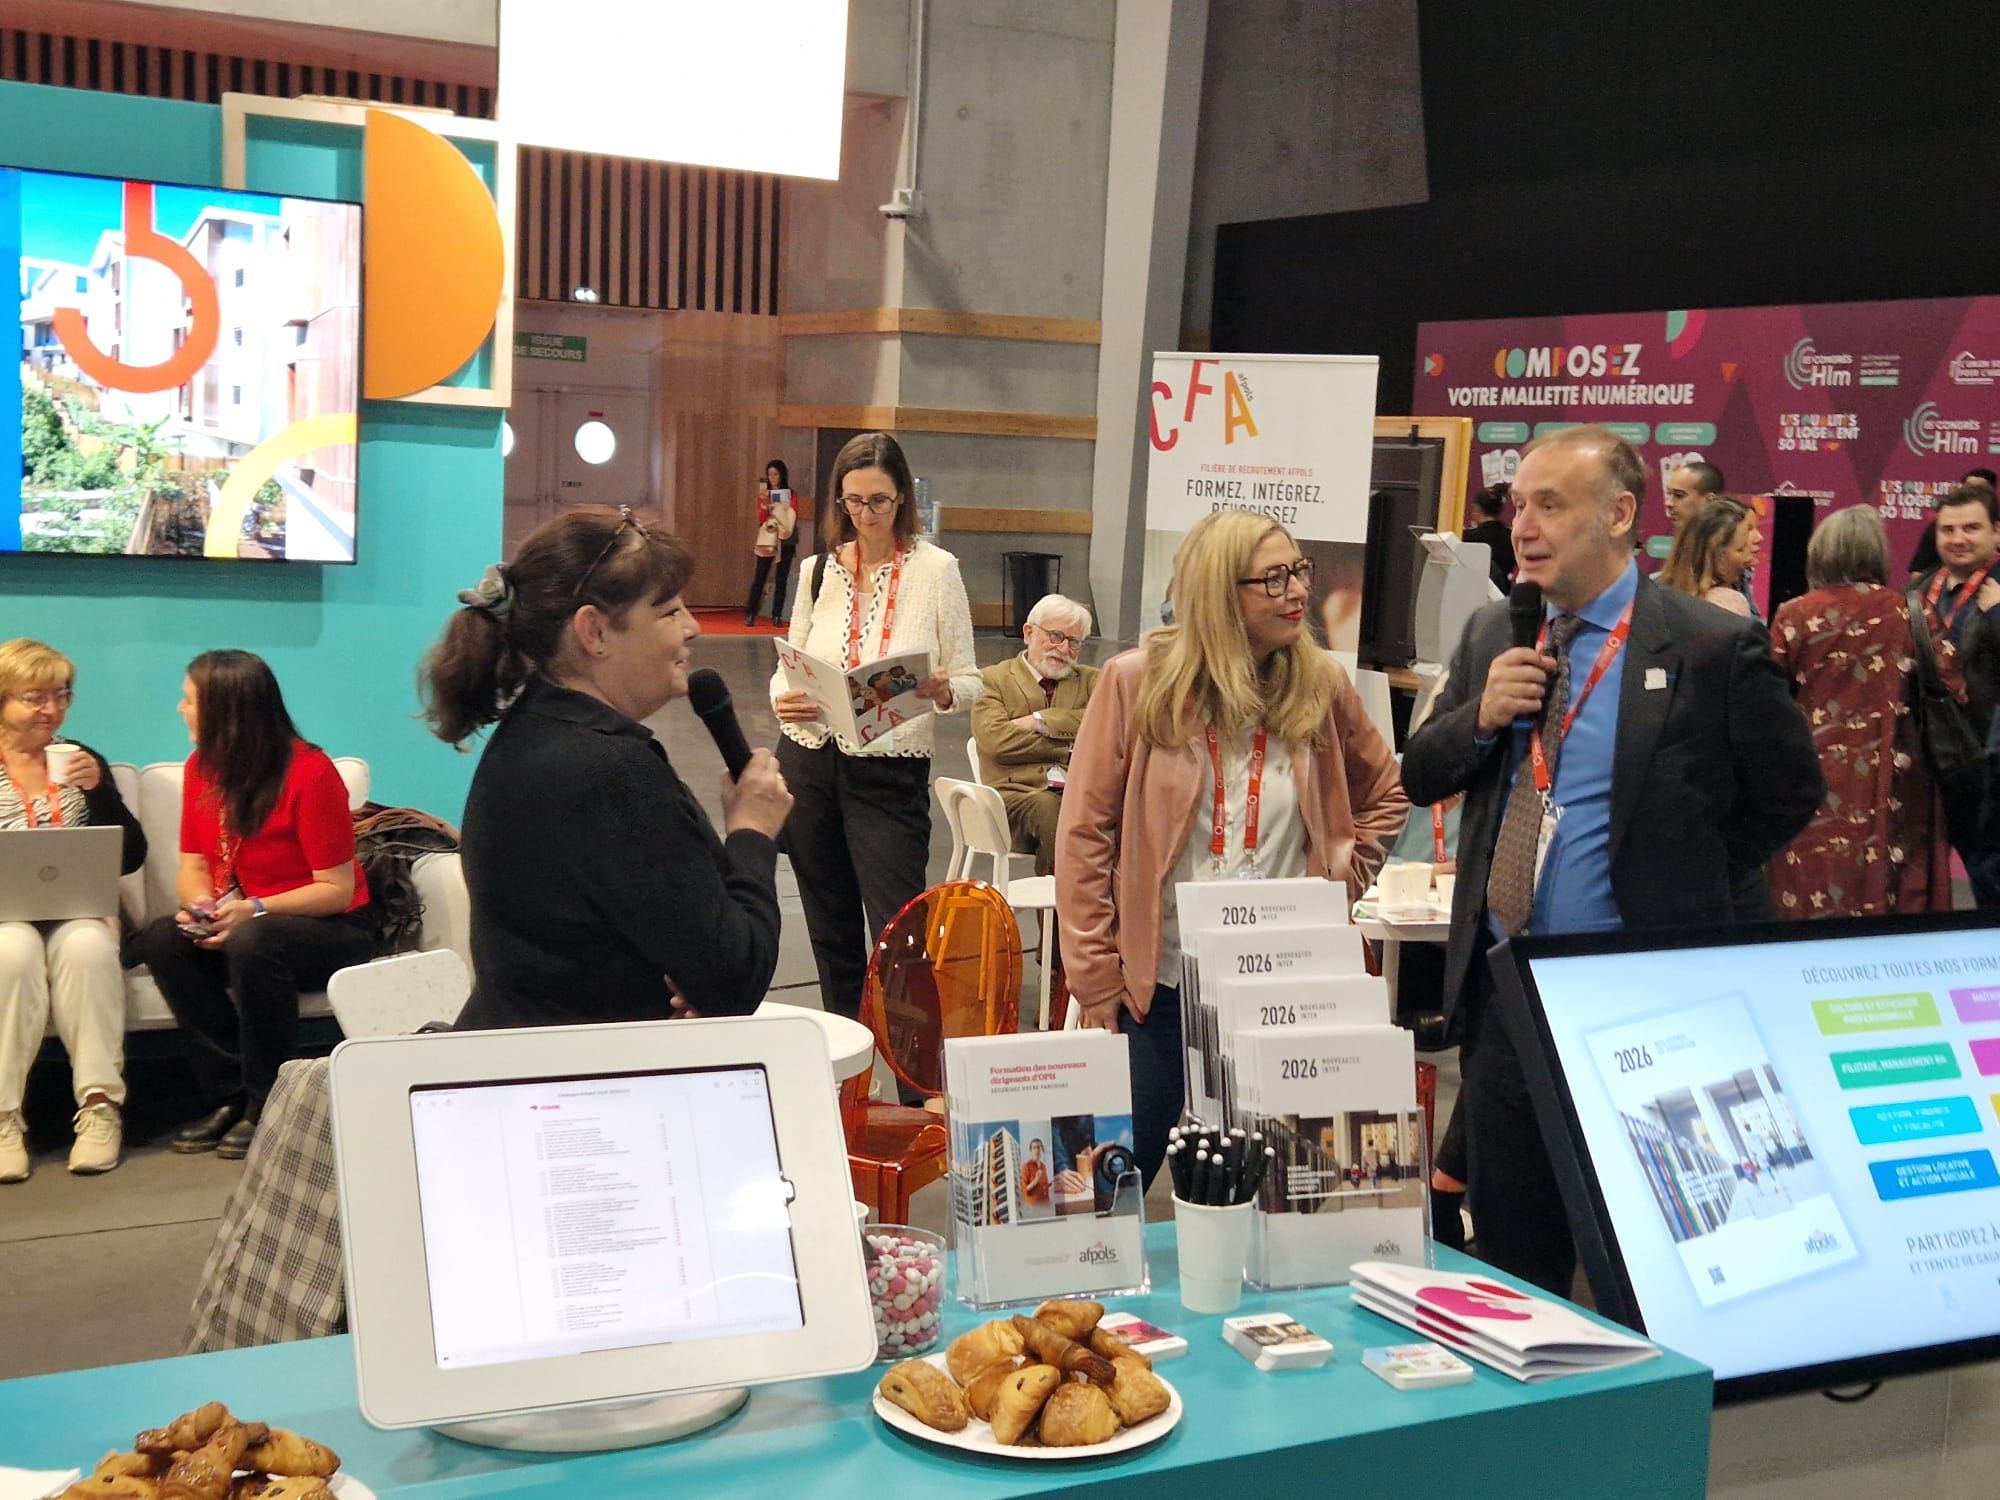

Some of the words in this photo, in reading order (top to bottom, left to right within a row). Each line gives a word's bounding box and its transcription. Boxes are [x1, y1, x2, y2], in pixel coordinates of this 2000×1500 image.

[529, 347, 582, 360] SECOURS
[1448, 386, 1498, 406] VOTRE
[1500, 384, 1580, 406] MALLETTE
[1582, 378, 1695, 405] NUMÉRIQUE
[1149, 359, 1258, 452] CFA
[1238, 465, 1286, 476] RECRUTEMENT
[1222, 905, 1257, 925] 2026
[1237, 953, 1272, 974] 2026
[1801, 964, 1881, 985] DÉCOUVREZ
[1881, 959, 1933, 979] TOUTES
[1933, 957, 1962, 975] NOS
[1260, 1005, 1297, 1026] 2026
[990, 1065, 1032, 1075] Formation
[1033, 1063, 1046, 1073] des
[1048, 1061, 1087, 1071] nouveaux
[1614, 1044, 1654, 1073] 2026
[1281, 1058, 1318, 1080] 2026
[990, 1075, 1031, 1086] dirigeants
[1911, 1174, 1943, 1187] ACTION
[1373, 1242, 1401, 1257] afpols
[1906, 1226, 1990, 1253] PARTICIPEZ
[1079, 1245, 1117, 1265] afpols
[1925, 1257, 1961, 1273] TENTEZ
[1962, 1254, 1975, 1267] DE
